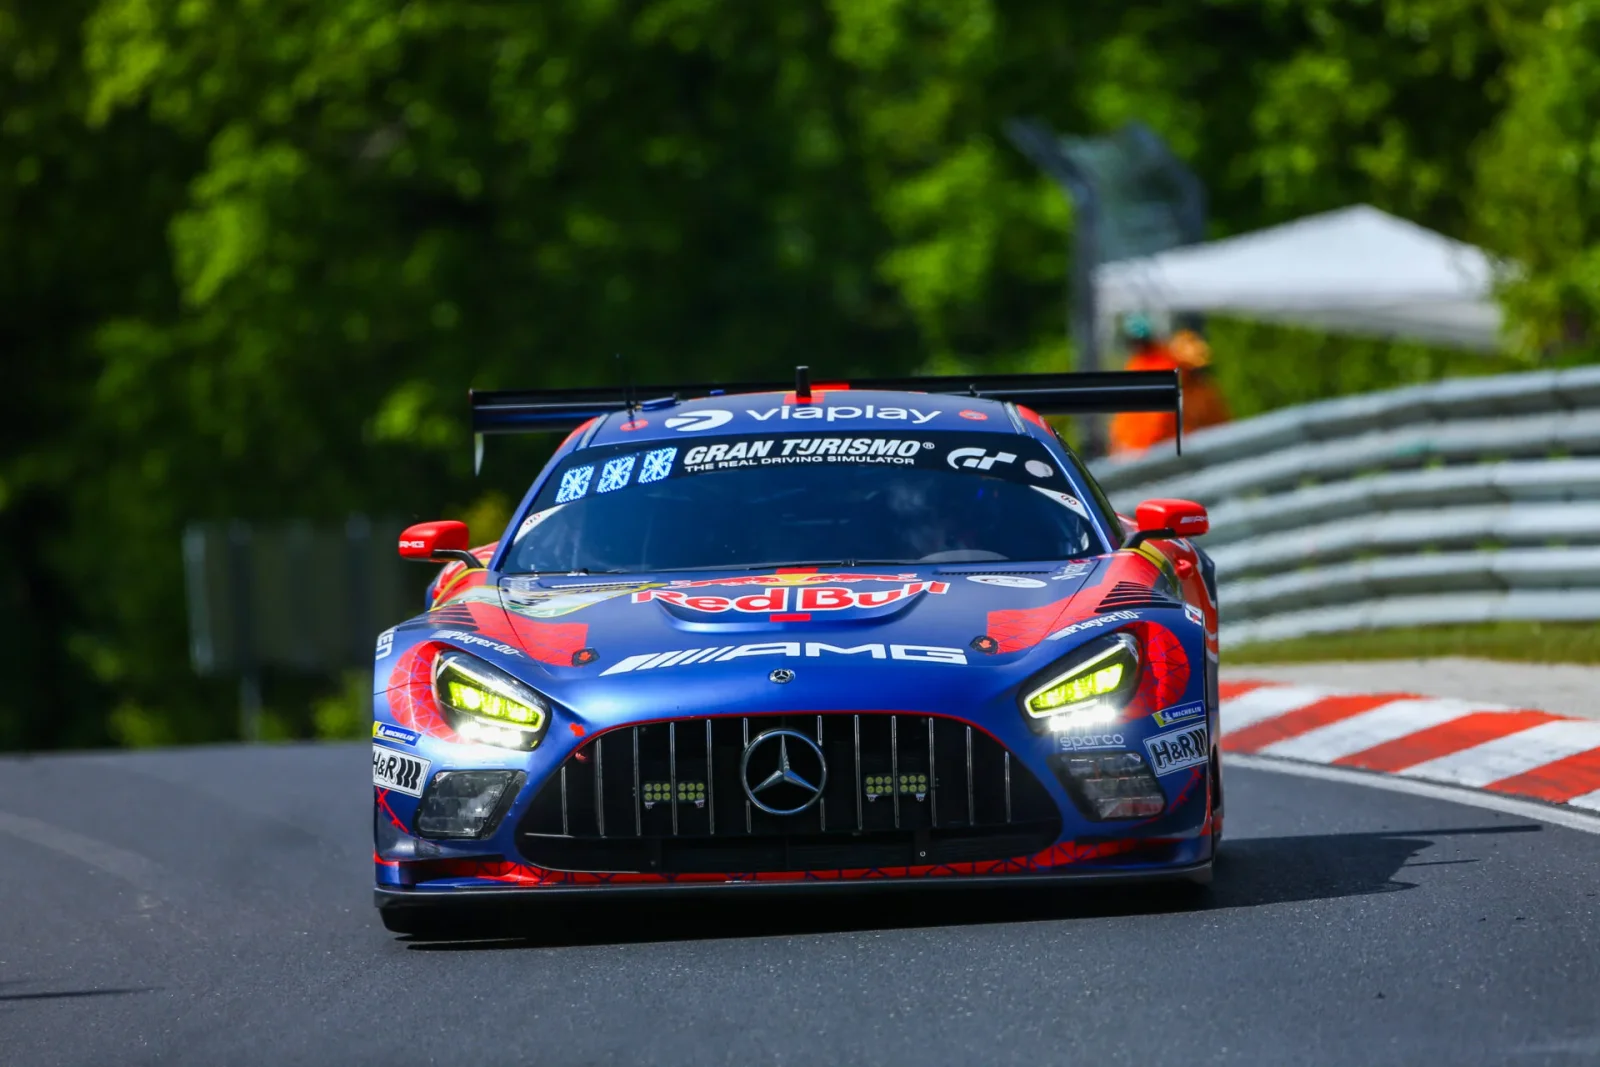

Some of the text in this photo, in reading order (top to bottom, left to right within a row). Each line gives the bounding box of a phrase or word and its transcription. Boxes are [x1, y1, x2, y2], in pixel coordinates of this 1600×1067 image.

[746, 405, 942, 424] viaplay
[683, 440, 774, 465] GRAN
[685, 455, 915, 472] THE REAL DRIVING SIMULATOR
[632, 581, 950, 612] Red Bull
[1172, 706, 1202, 718] MICHELIN
[384, 729, 416, 742] MICHELIN
[1060, 733, 1124, 751] sparco
